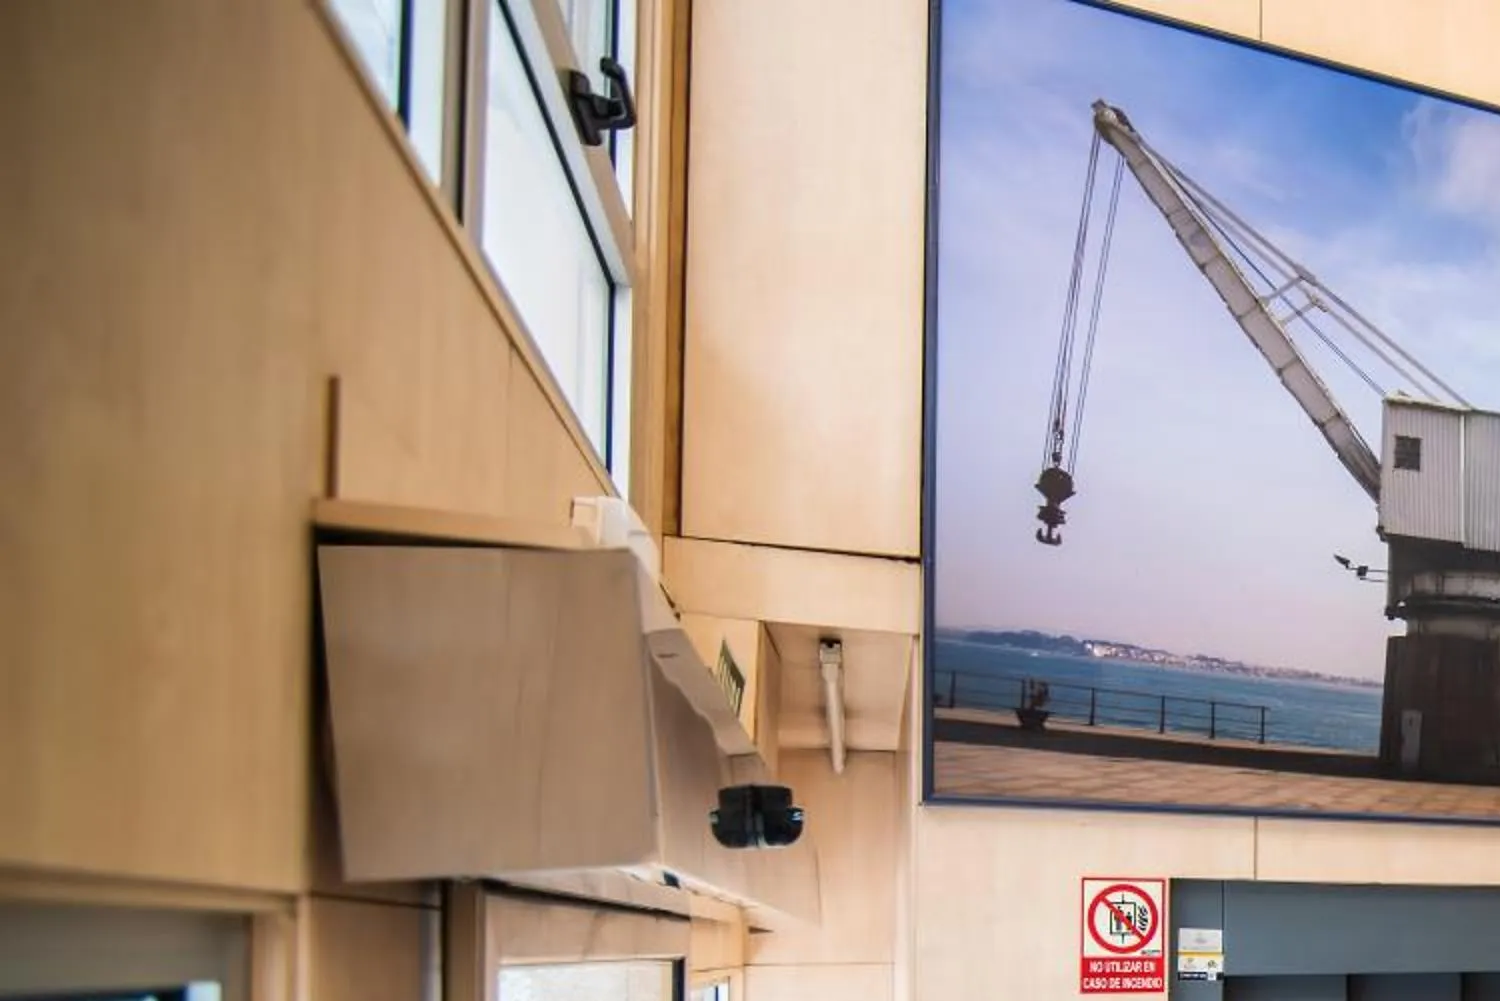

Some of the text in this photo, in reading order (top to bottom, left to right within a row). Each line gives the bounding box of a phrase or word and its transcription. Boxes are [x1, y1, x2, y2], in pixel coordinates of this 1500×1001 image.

[1089, 961, 1156, 973] NO UTILIZAR EN
[1083, 977, 1163, 989] CASO DE INCENDIO
